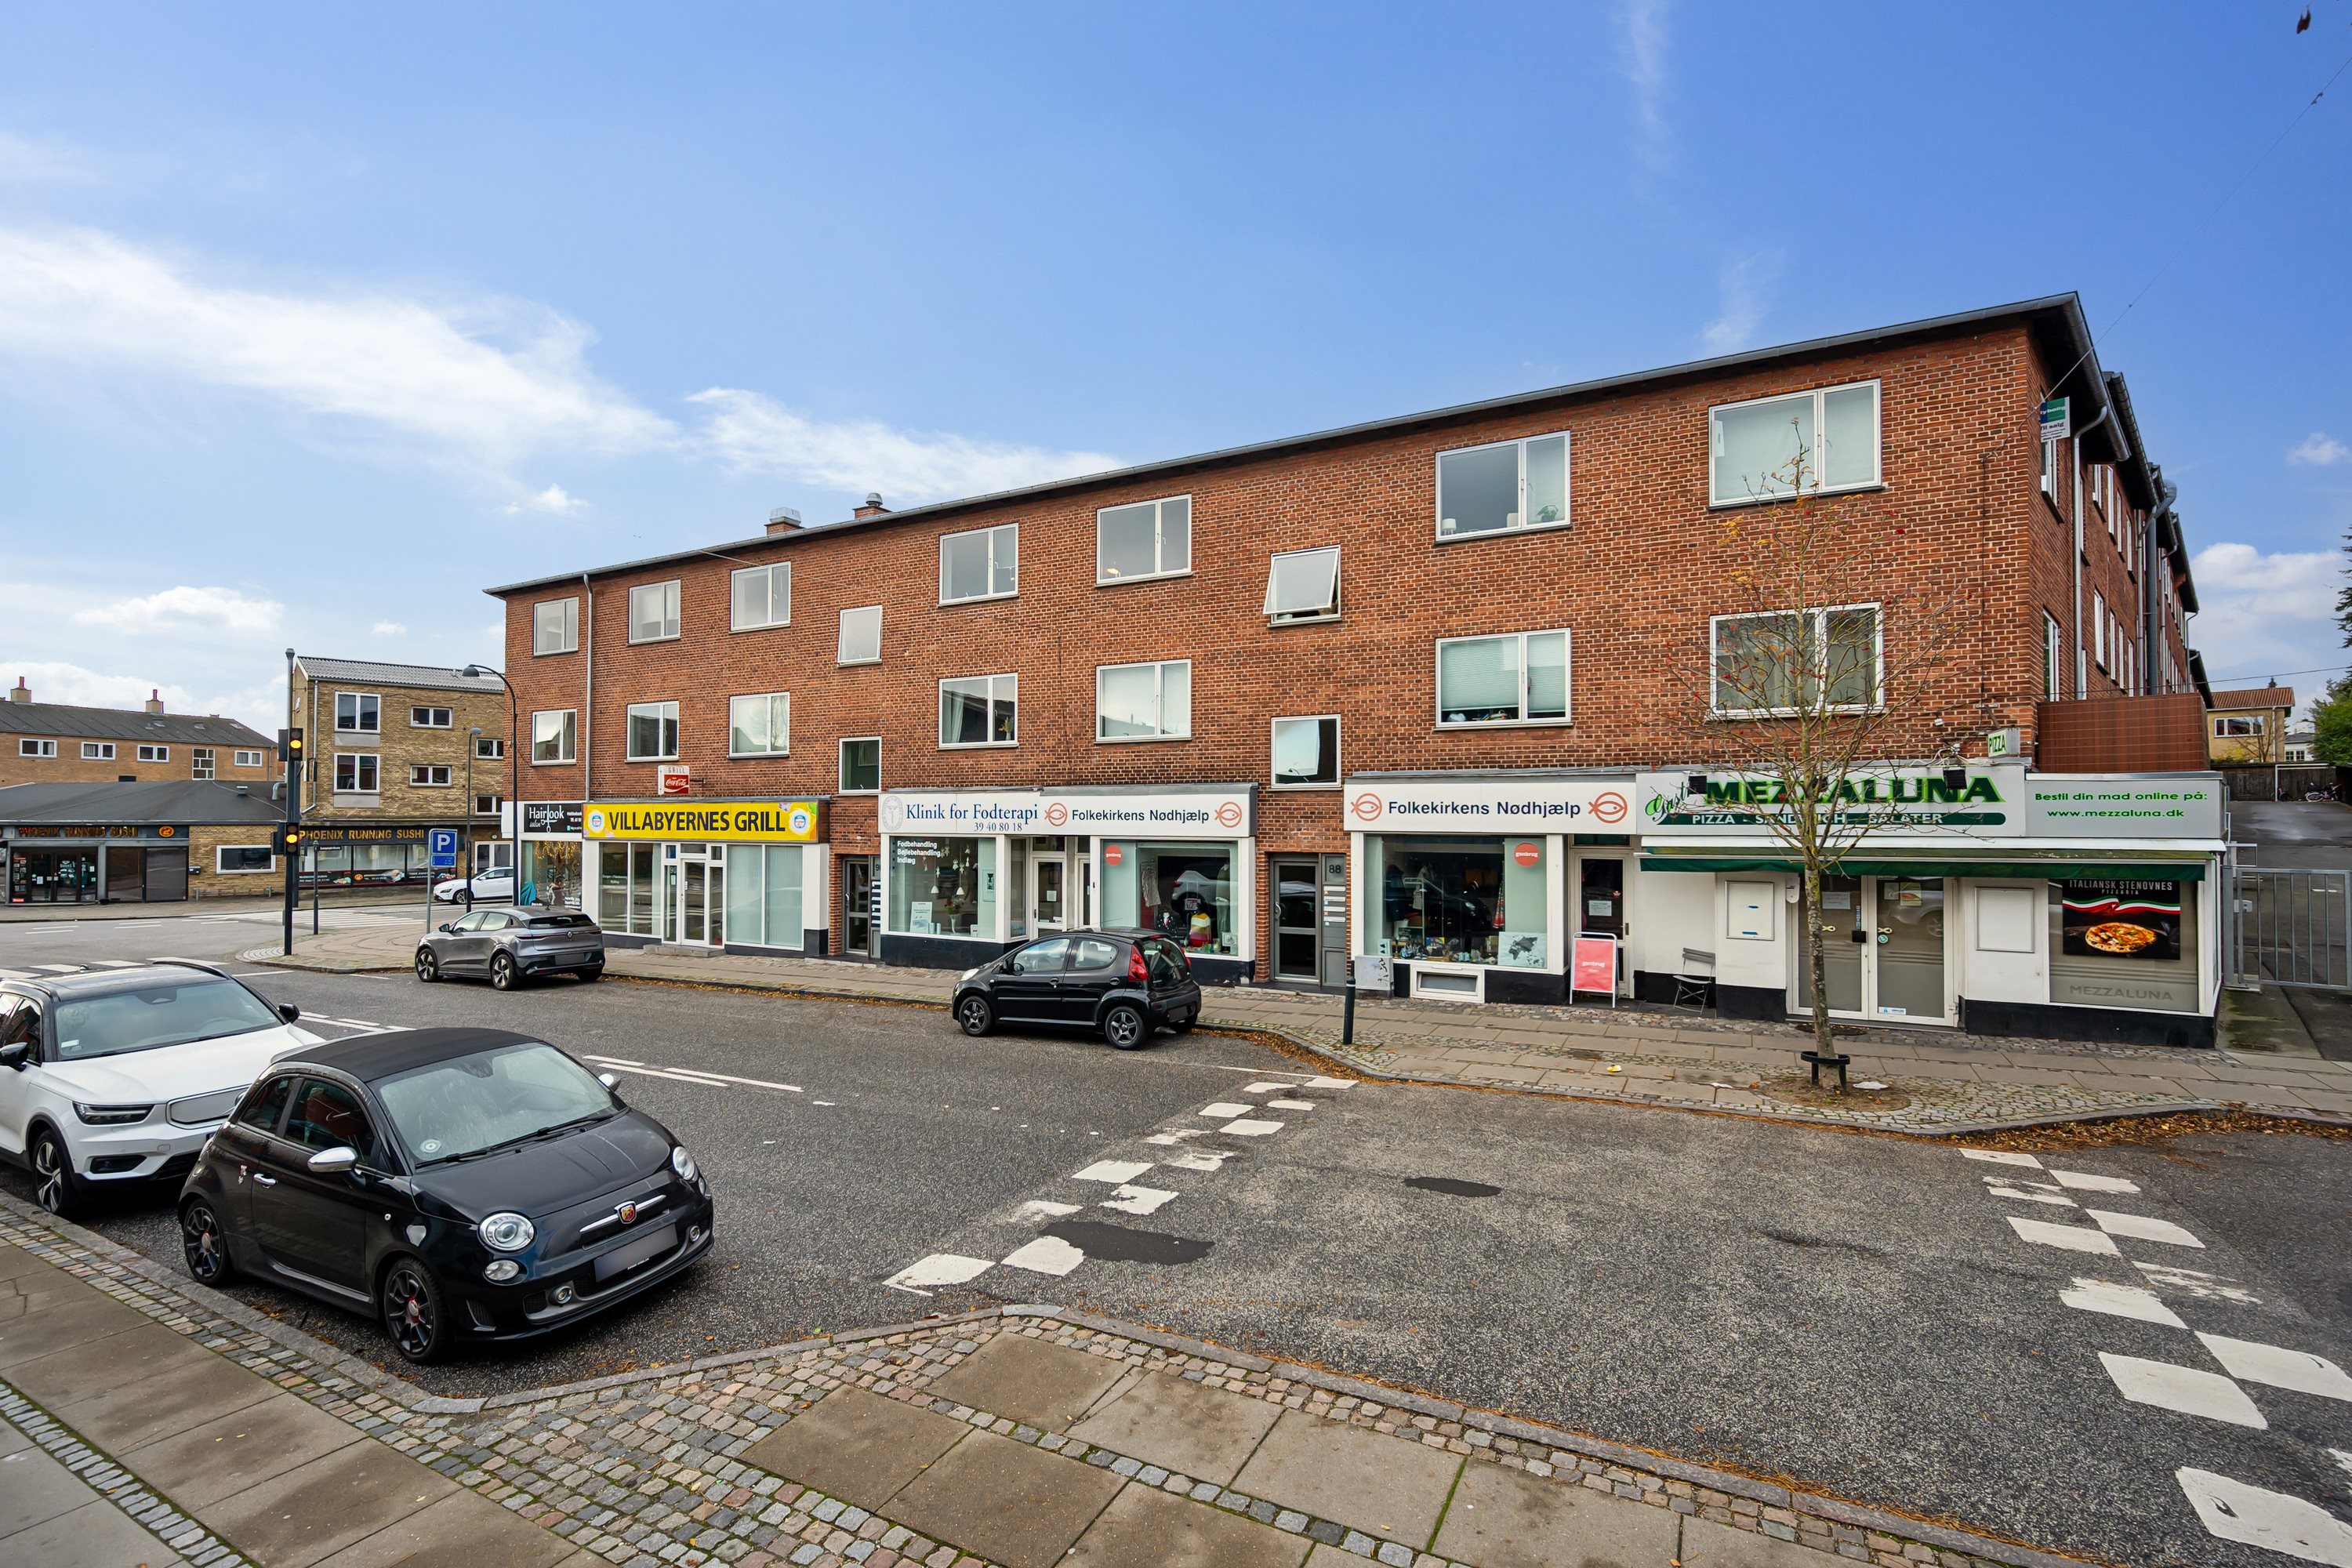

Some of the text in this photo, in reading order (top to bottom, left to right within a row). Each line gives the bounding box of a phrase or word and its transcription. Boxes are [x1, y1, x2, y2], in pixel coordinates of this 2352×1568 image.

[1989, 734, 2005, 753] PIZZA
[666, 778, 687, 786] Coca-Cola
[2098, 792, 2130, 800] mad
[2135, 792, 2180, 800] online
[2183, 791, 2208, 801] på:
[906, 804, 946, 819] Klinik
[950, 803, 968, 819] for
[972, 803, 1038, 825] Fodterapi
[1388, 800, 1581, 818] Folkekirkens Nødhjælp
[608, 811, 786, 832] VILLABYERNES GRILL
[1072, 809, 1209, 823] Folkekirkens Nødhjælp
[1692, 815, 1735, 824] PIZZA
[18, 826, 139, 837] PHOENIX RUNNING SUSHI
[974, 822, 1022, 832] 39 40 80 18
[299, 829, 424, 840] PHOENIX RUNNING SUSHI
[437, 834, 451, 851] P
[897, 840, 938, 849] Fodbehandling
[1329, 865, 1341, 873] 88
[2069, 879, 2172, 891] ITALIANSK STENOVNES
[2070, 985, 2174, 1000] MEZZALUNA
